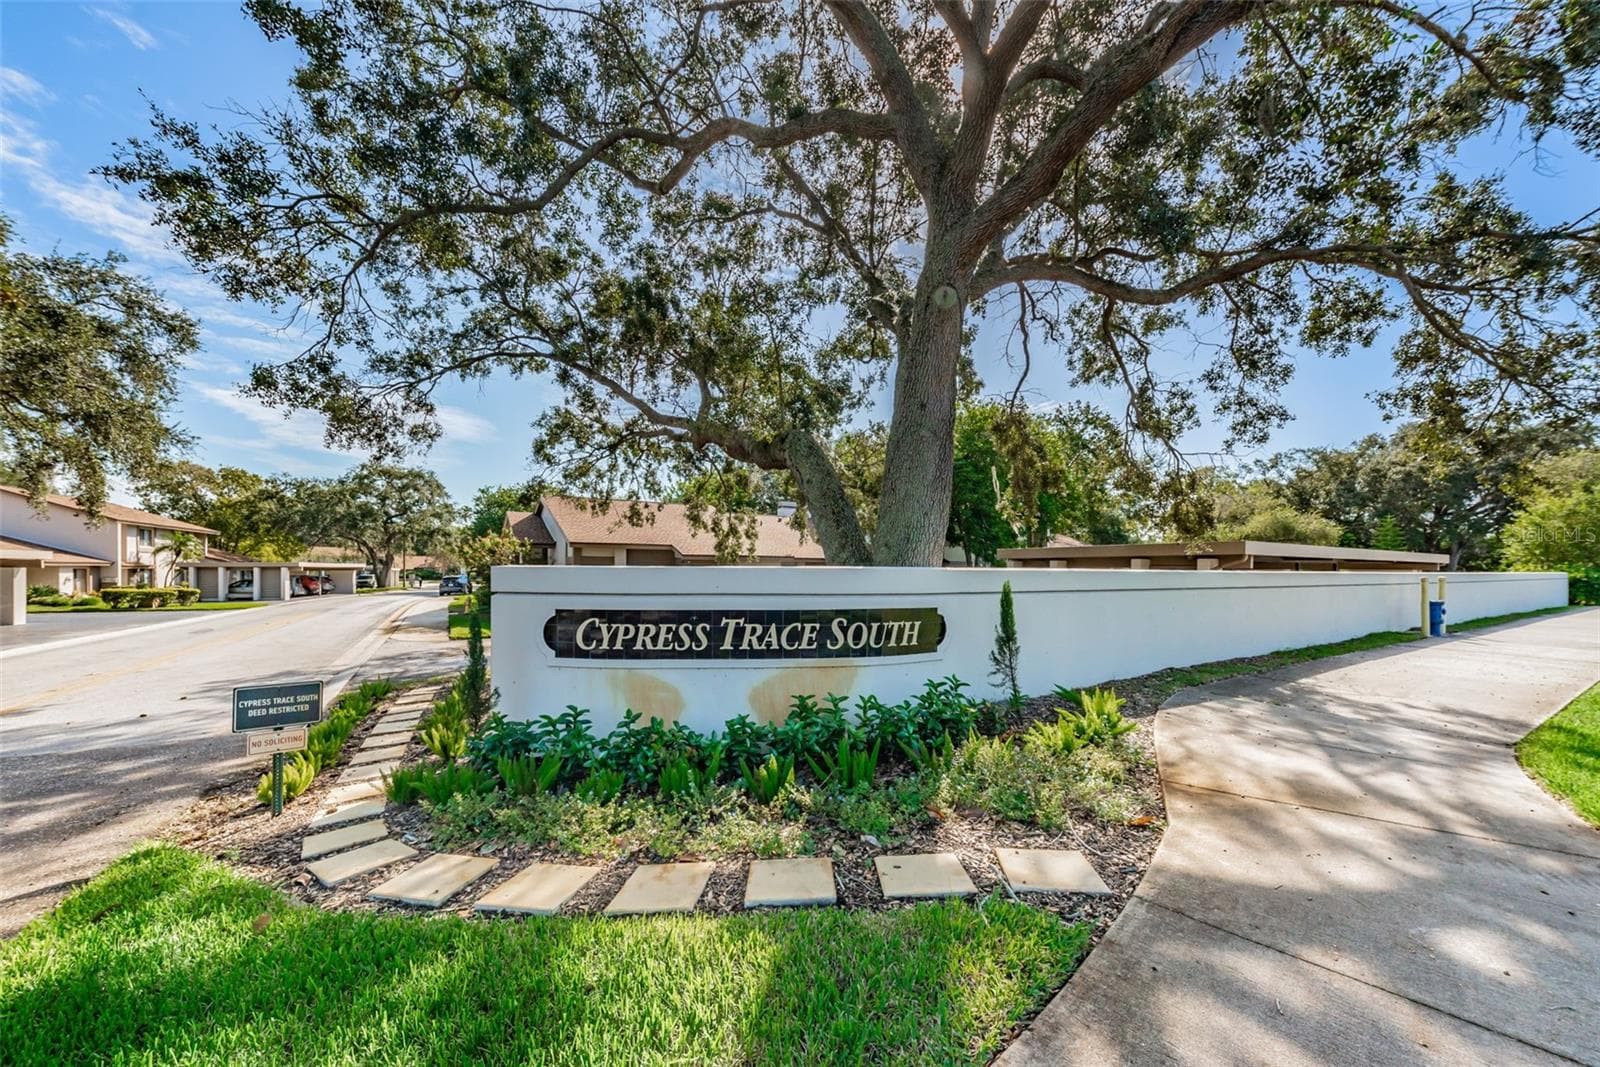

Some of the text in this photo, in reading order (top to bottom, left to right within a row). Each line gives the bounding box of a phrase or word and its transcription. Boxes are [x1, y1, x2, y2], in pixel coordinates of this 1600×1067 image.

[575, 616, 922, 651] CYPRESS TRACE SOUTH
[238, 693, 318, 708] CYPRESS TRACE SOUTH
[248, 704, 310, 717] DEED RESTRICTED
[264, 734, 304, 747] SOLICITING
